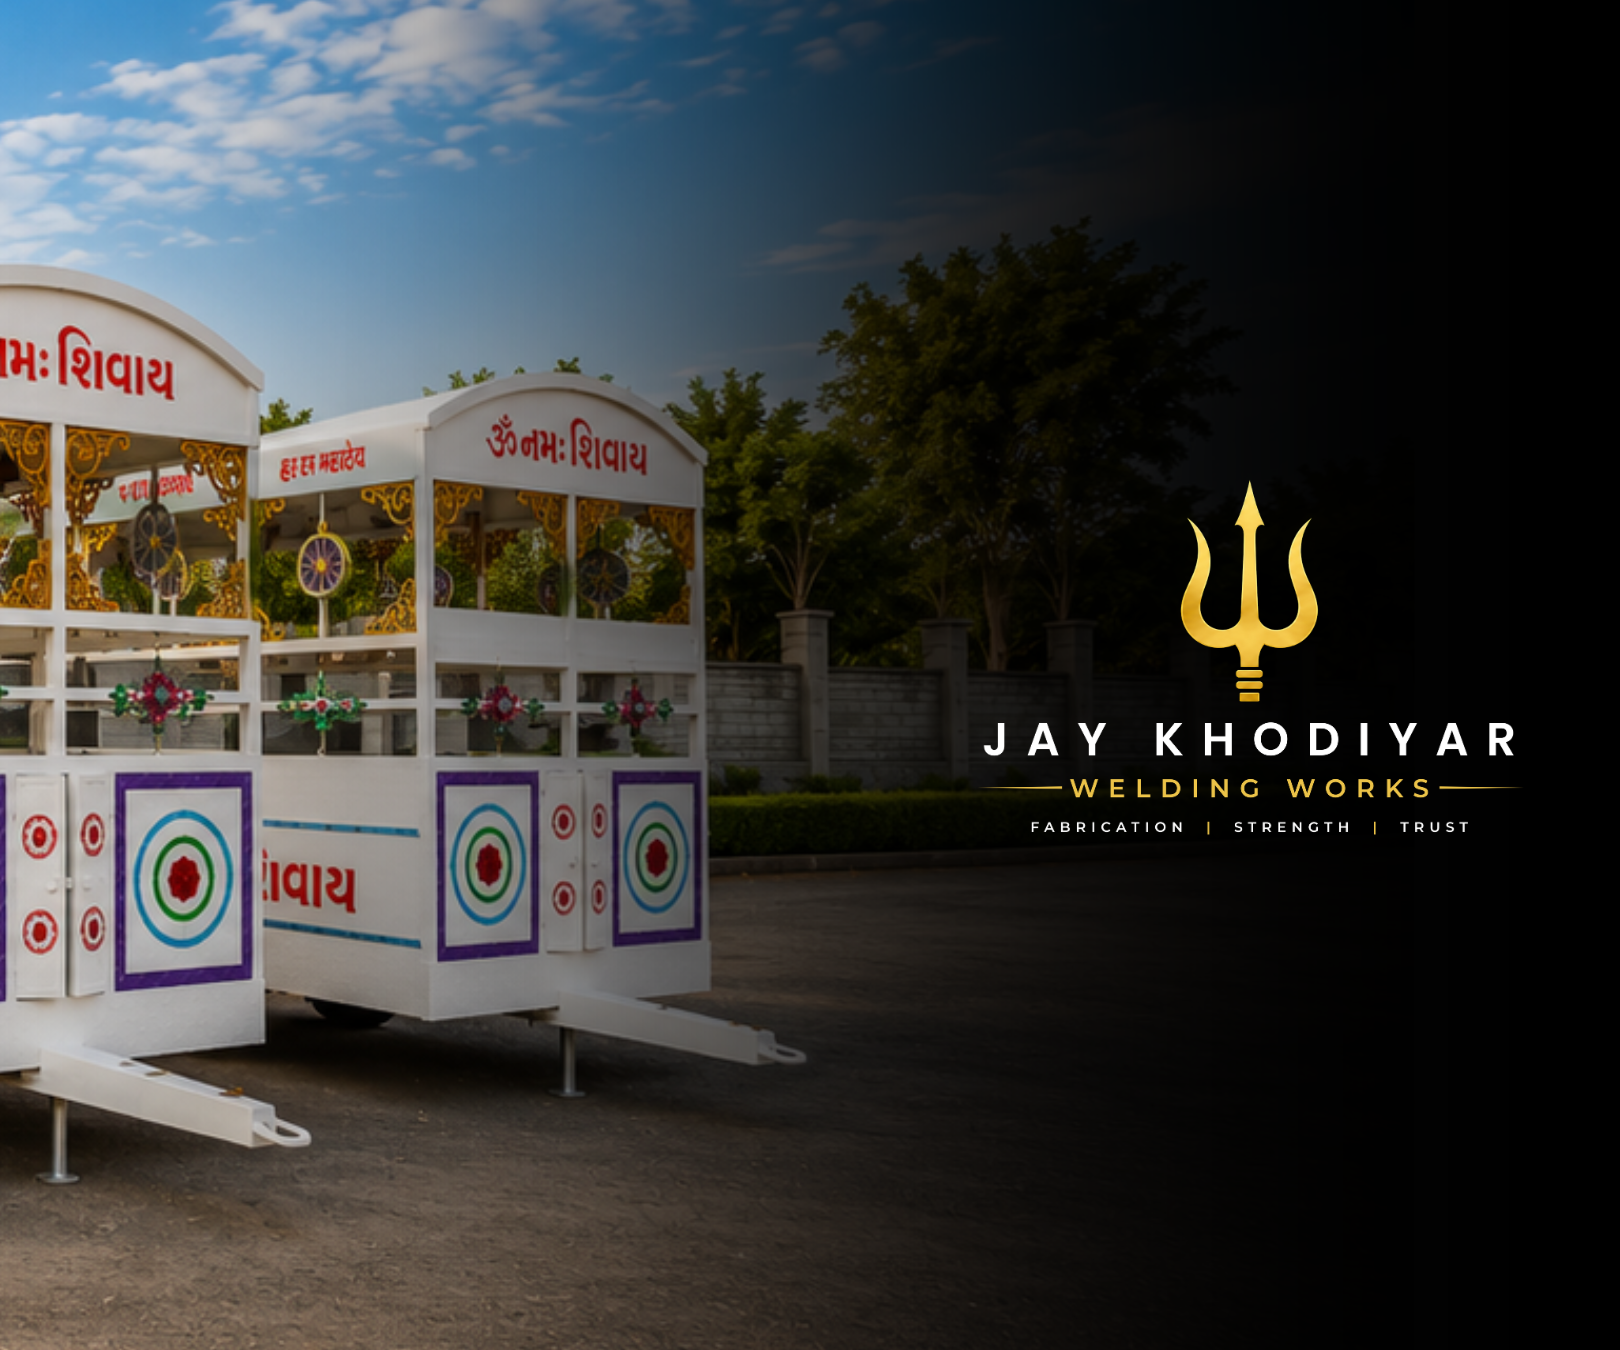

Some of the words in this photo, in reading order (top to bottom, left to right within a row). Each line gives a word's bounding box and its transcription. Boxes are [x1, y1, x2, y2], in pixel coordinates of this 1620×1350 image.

[58, 325, 175, 400] શિવાય
[570, 417, 648, 476] શિવાય
[262, 849, 356, 914] વાય
